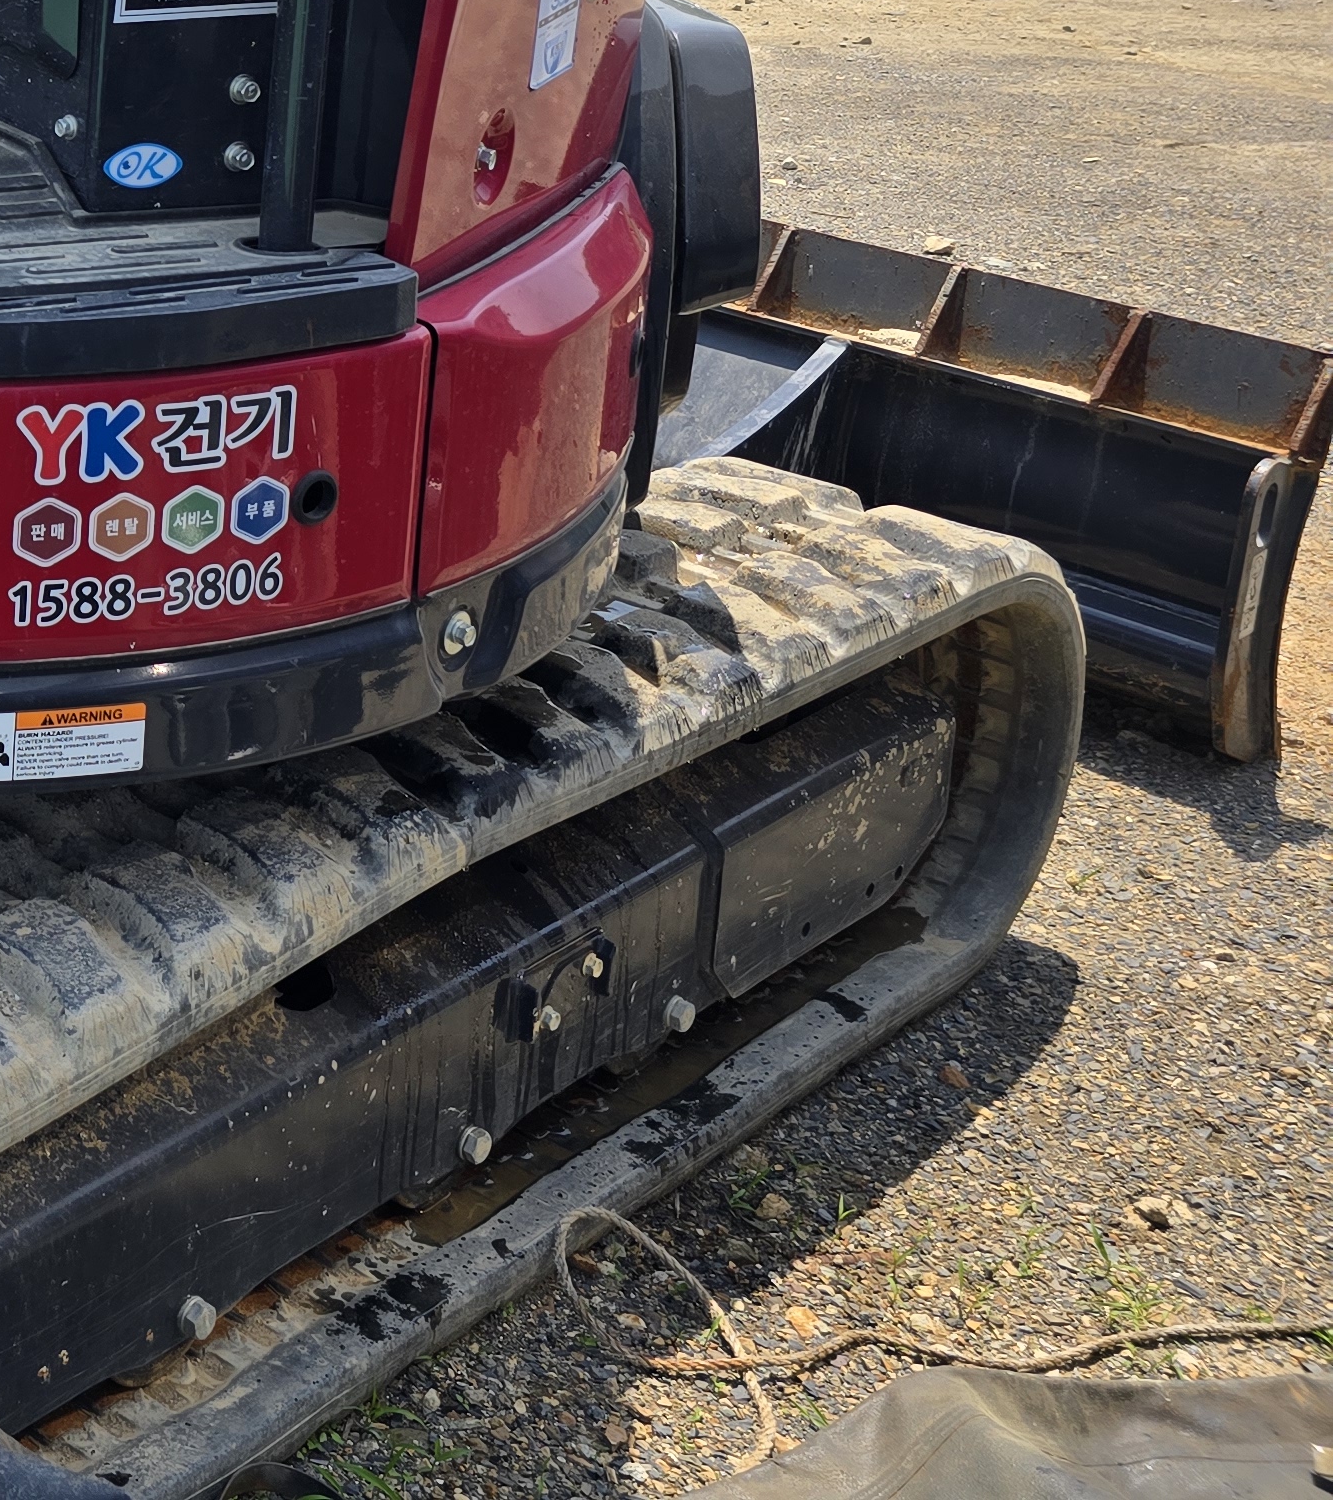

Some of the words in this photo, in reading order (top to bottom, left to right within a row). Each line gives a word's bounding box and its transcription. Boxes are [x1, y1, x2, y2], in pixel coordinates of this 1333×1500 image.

[117, 151, 168, 180] OK
[16, 399, 145, 485] YK
[151, 385, 297, 473] 건기
[172, 508, 214, 529] 서비스
[245, 499, 276, 521] 부품
[30, 522, 65, 542] 판매
[105, 517, 139, 537] 렌탈
[8, 552, 281, 627] 1588-3806
[57, 709, 123, 725] WARNING
[18, 738, 51, 746] CONTENTS
